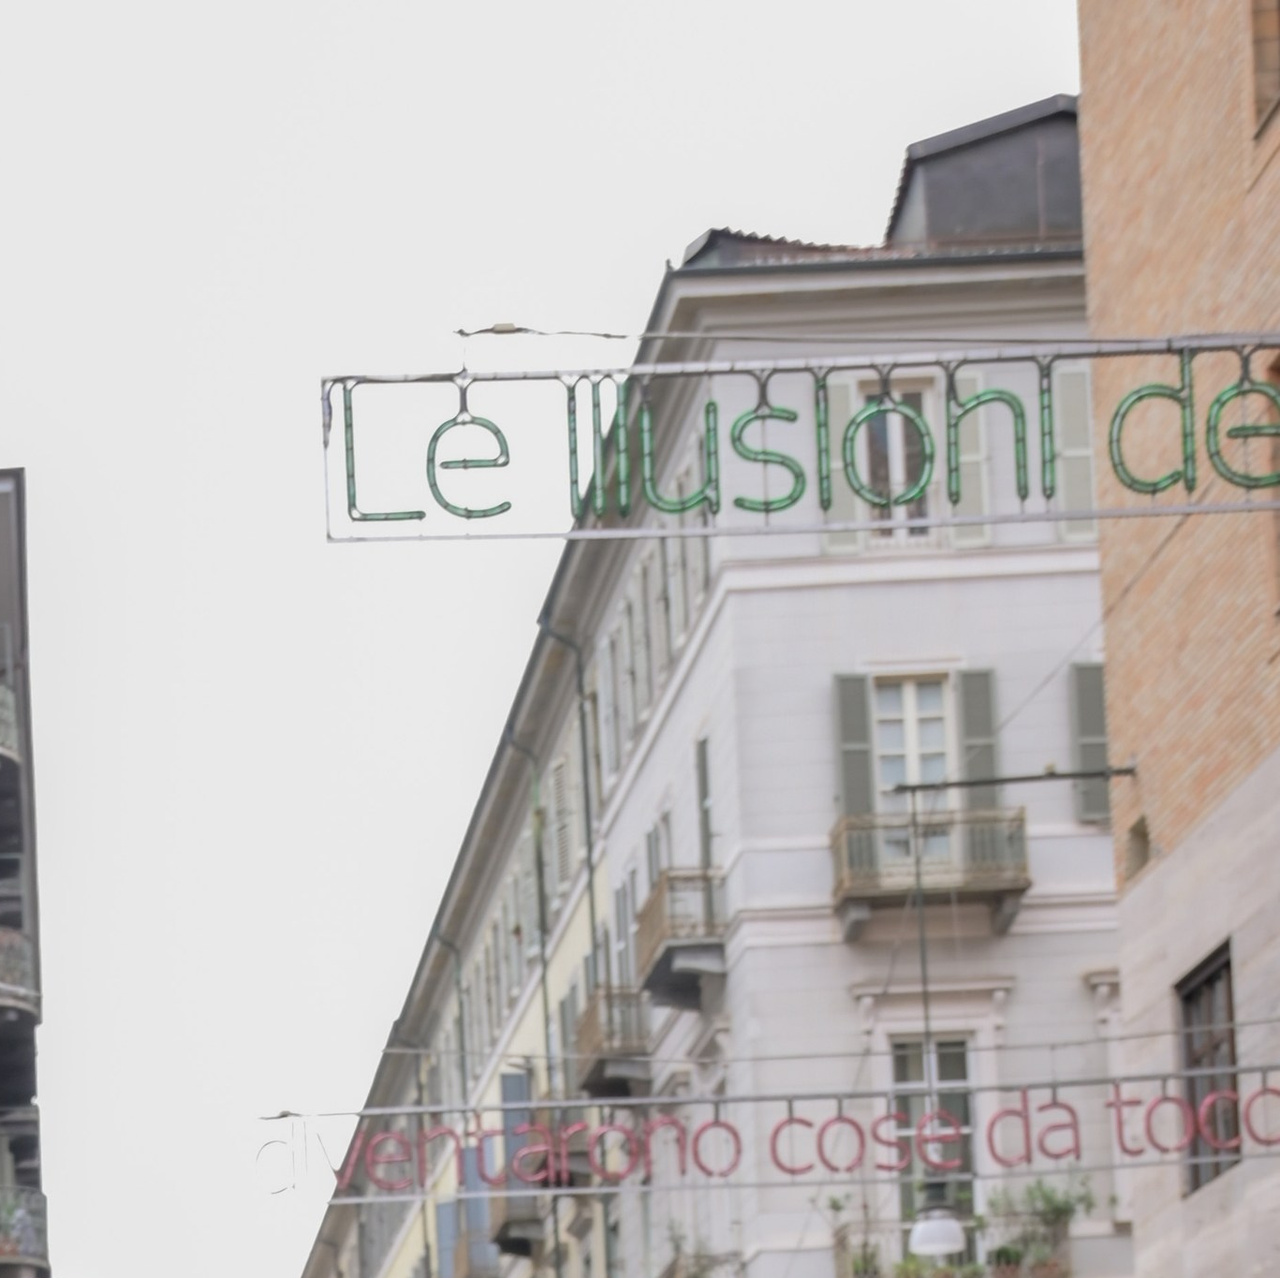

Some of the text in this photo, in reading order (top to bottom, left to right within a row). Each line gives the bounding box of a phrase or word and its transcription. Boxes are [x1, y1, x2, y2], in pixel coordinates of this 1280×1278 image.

[342, 384, 512, 519] Le
[770, 1109, 963, 1176] cose
[986, 1087, 1082, 1168] da
